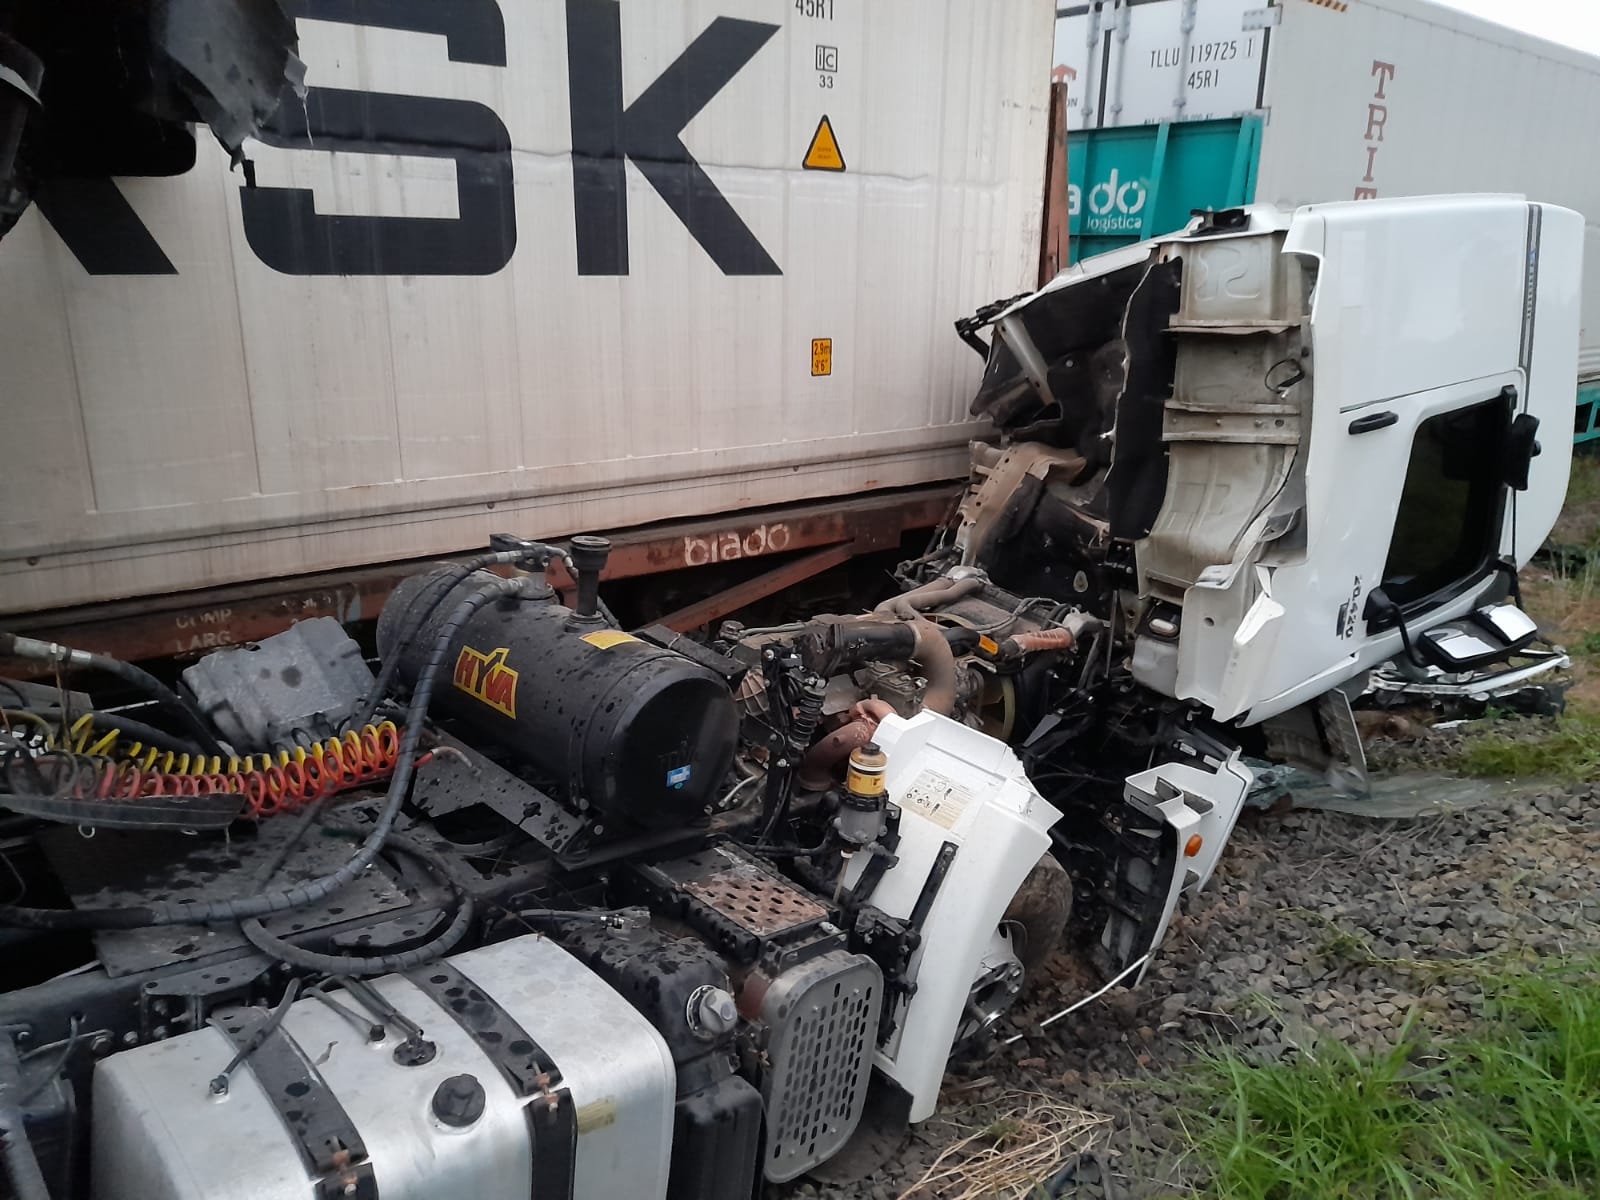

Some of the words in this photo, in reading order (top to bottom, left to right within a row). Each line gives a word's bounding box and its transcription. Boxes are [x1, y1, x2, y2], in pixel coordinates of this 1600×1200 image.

[1151, 47, 1180, 69] TLLU
[1190, 40, 1237, 64] 119725
[819, 74, 834, 90] 33
[1187, 69, 1219, 89] 45R1
[456, 649, 515, 713] HYVA
